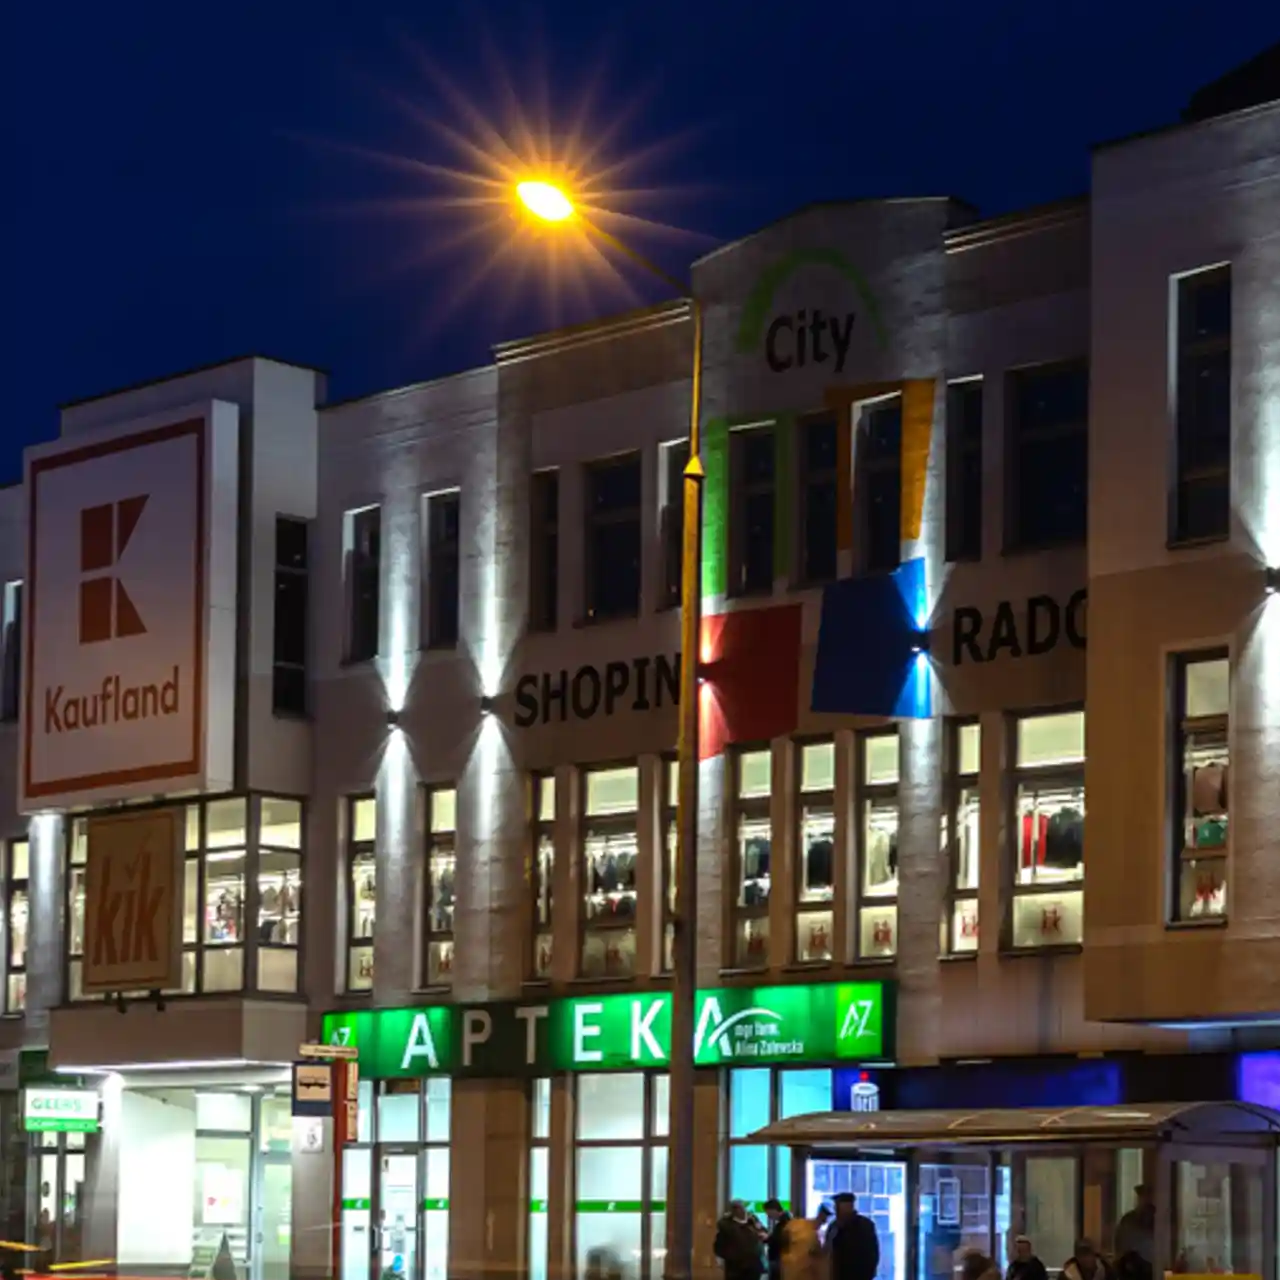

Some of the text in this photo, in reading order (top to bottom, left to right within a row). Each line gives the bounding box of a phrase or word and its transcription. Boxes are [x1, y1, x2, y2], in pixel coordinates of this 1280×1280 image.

[766, 309, 855, 373] City
[45, 666, 179, 734] Kaufland
[92, 834, 165, 967] kik
[401, 997, 732, 1069] APTEKA
